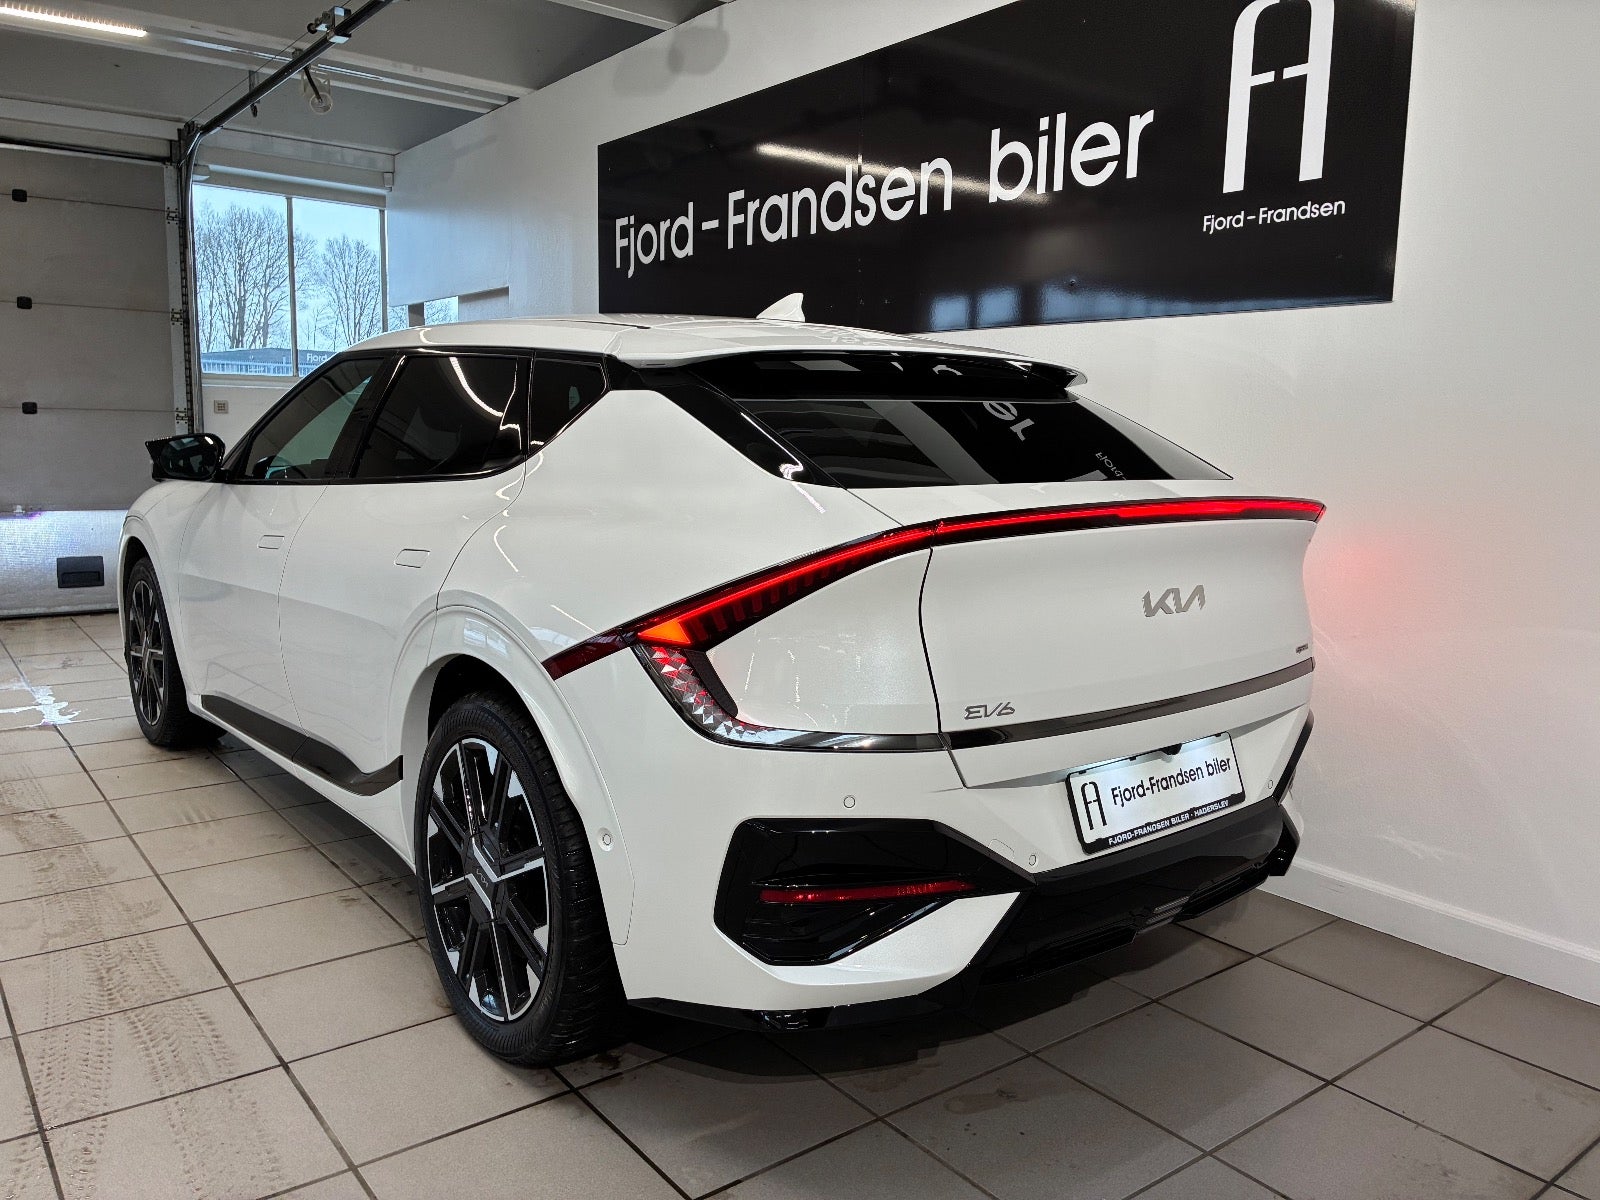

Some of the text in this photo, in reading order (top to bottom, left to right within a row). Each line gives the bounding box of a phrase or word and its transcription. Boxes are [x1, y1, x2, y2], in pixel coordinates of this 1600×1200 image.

[989, 109, 1155, 203] biler
[1142, 584, 1206, 618] KIA
[964, 701, 1016, 720] EV6
[1111, 757, 1231, 807] Fjord-Frandsen biler
[1108, 800, 1229, 846] FJORD-FRANDSEN BILER HADERSLEV
